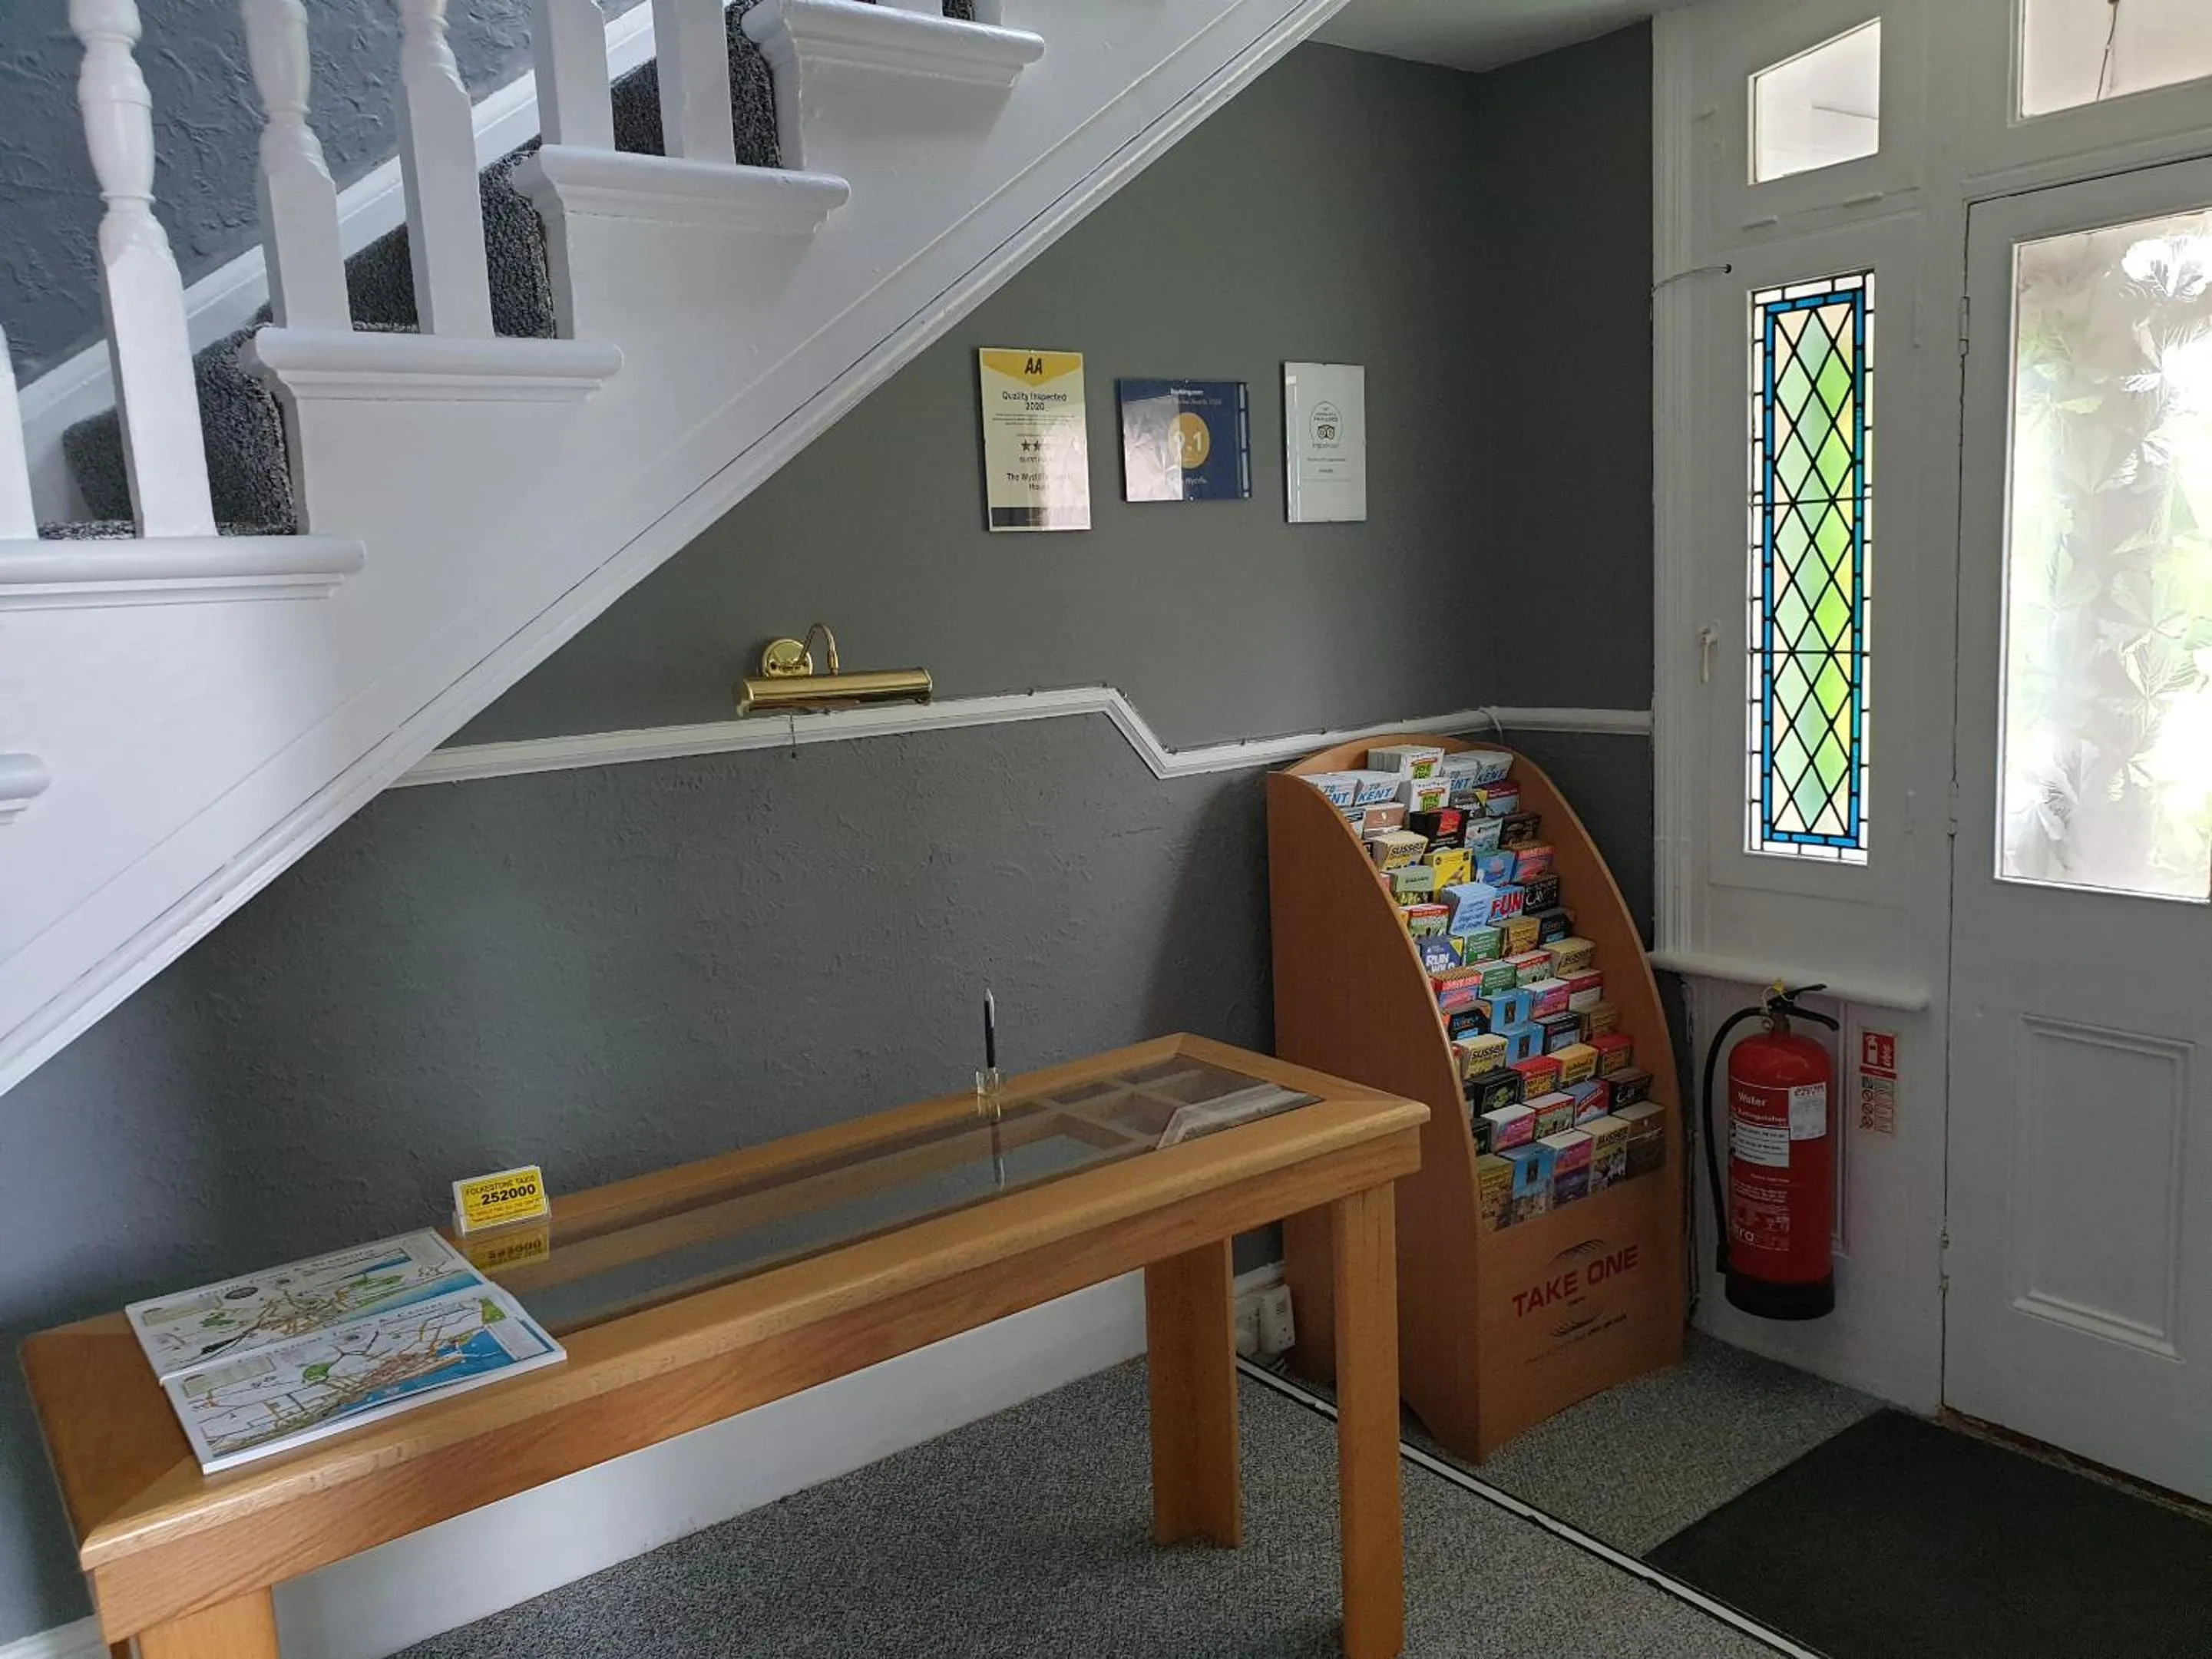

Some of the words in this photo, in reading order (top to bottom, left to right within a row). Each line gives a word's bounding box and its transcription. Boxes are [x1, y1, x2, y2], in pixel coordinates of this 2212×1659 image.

[1024, 357, 1043, 375] AA
[1002, 391, 1029, 401] Quality
[1030, 392, 1067, 402] Inspected
[1025, 402, 1045, 411] 2020
[1450, 777, 1470, 791] ENT
[1358, 787, 1391, 803] KENT
[481, 1184, 536, 1205] 252000
[1512, 1271, 1579, 1318] TAKE
[1588, 1244, 1638, 1285] ONE
